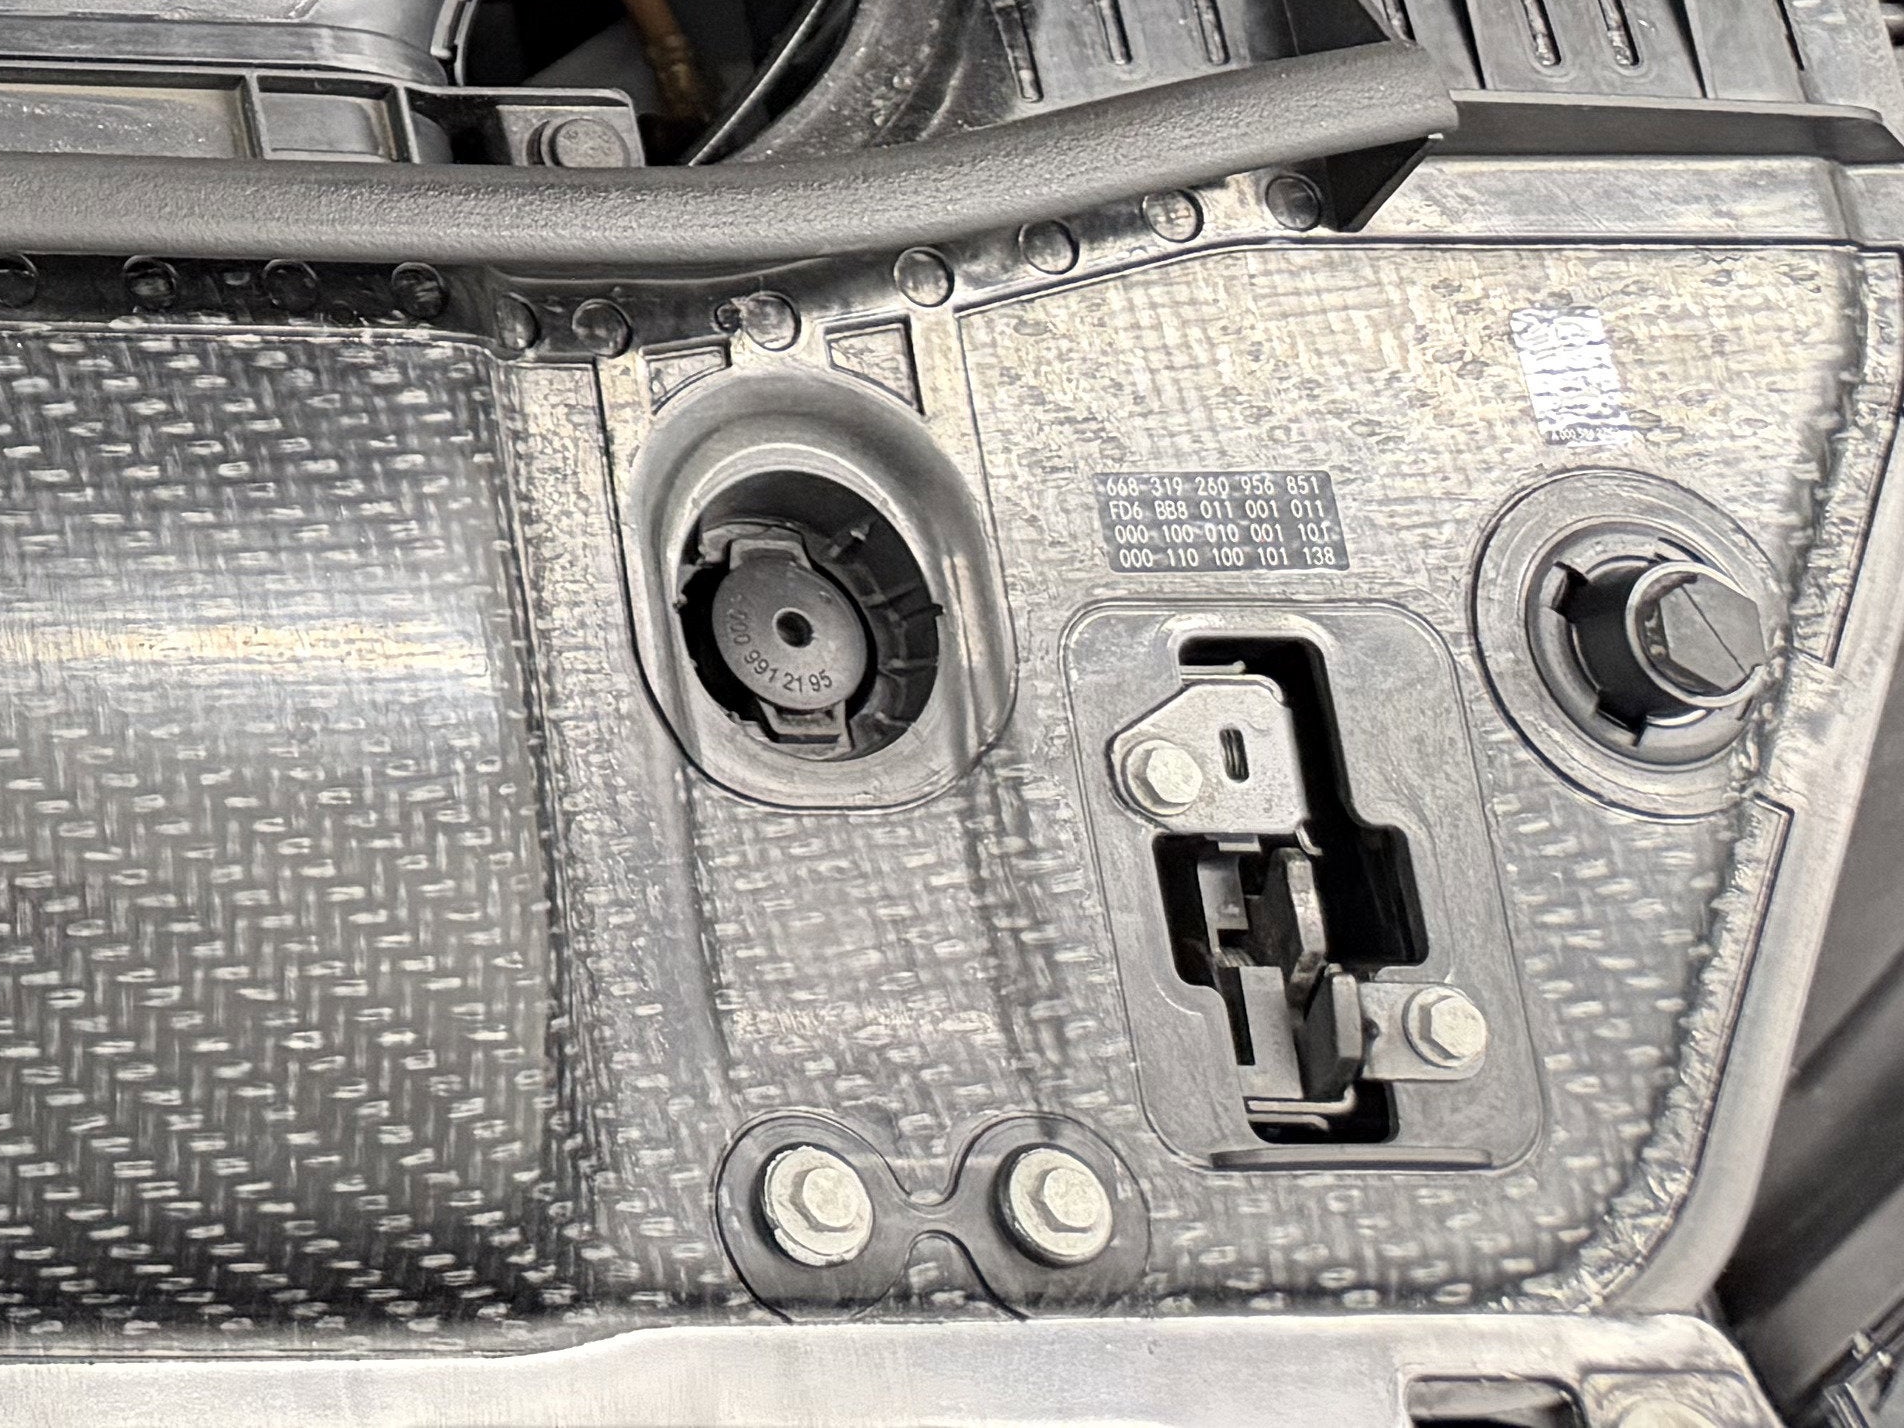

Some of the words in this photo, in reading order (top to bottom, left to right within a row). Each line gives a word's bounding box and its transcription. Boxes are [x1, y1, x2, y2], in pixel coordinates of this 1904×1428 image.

[1107, 477, 1138, 496] 668
[1150, 477, 1182, 496] 319
[1241, 477, 1274, 494] 956
[1287, 475, 1319, 495] 851
[1110, 501, 1142, 520] FD6
[1155, 501, 1188, 519] BB8
[1200, 501, 1233, 519] 011
[1246, 500, 1278, 518] 001
[1290, 500, 1324, 518] 011
[1115, 526, 1148, 543] 000
[1163, 525, 1193, 543] 100
[1205, 525, 1239, 542] 010
[1250, 524, 1283, 542] 001
[1298, 522, 1330, 542] 101
[1120, 549, 1153, 568] 000
[1167, 548, 1198, 567] 110
[1213, 548, 1243, 566] 100
[1258, 547, 1288, 566] 101
[1303, 547, 1334, 565] 138
[744, 649, 778, 683] 991
[782, 671, 803, 693] 21
[808, 669, 833, 693] 95
